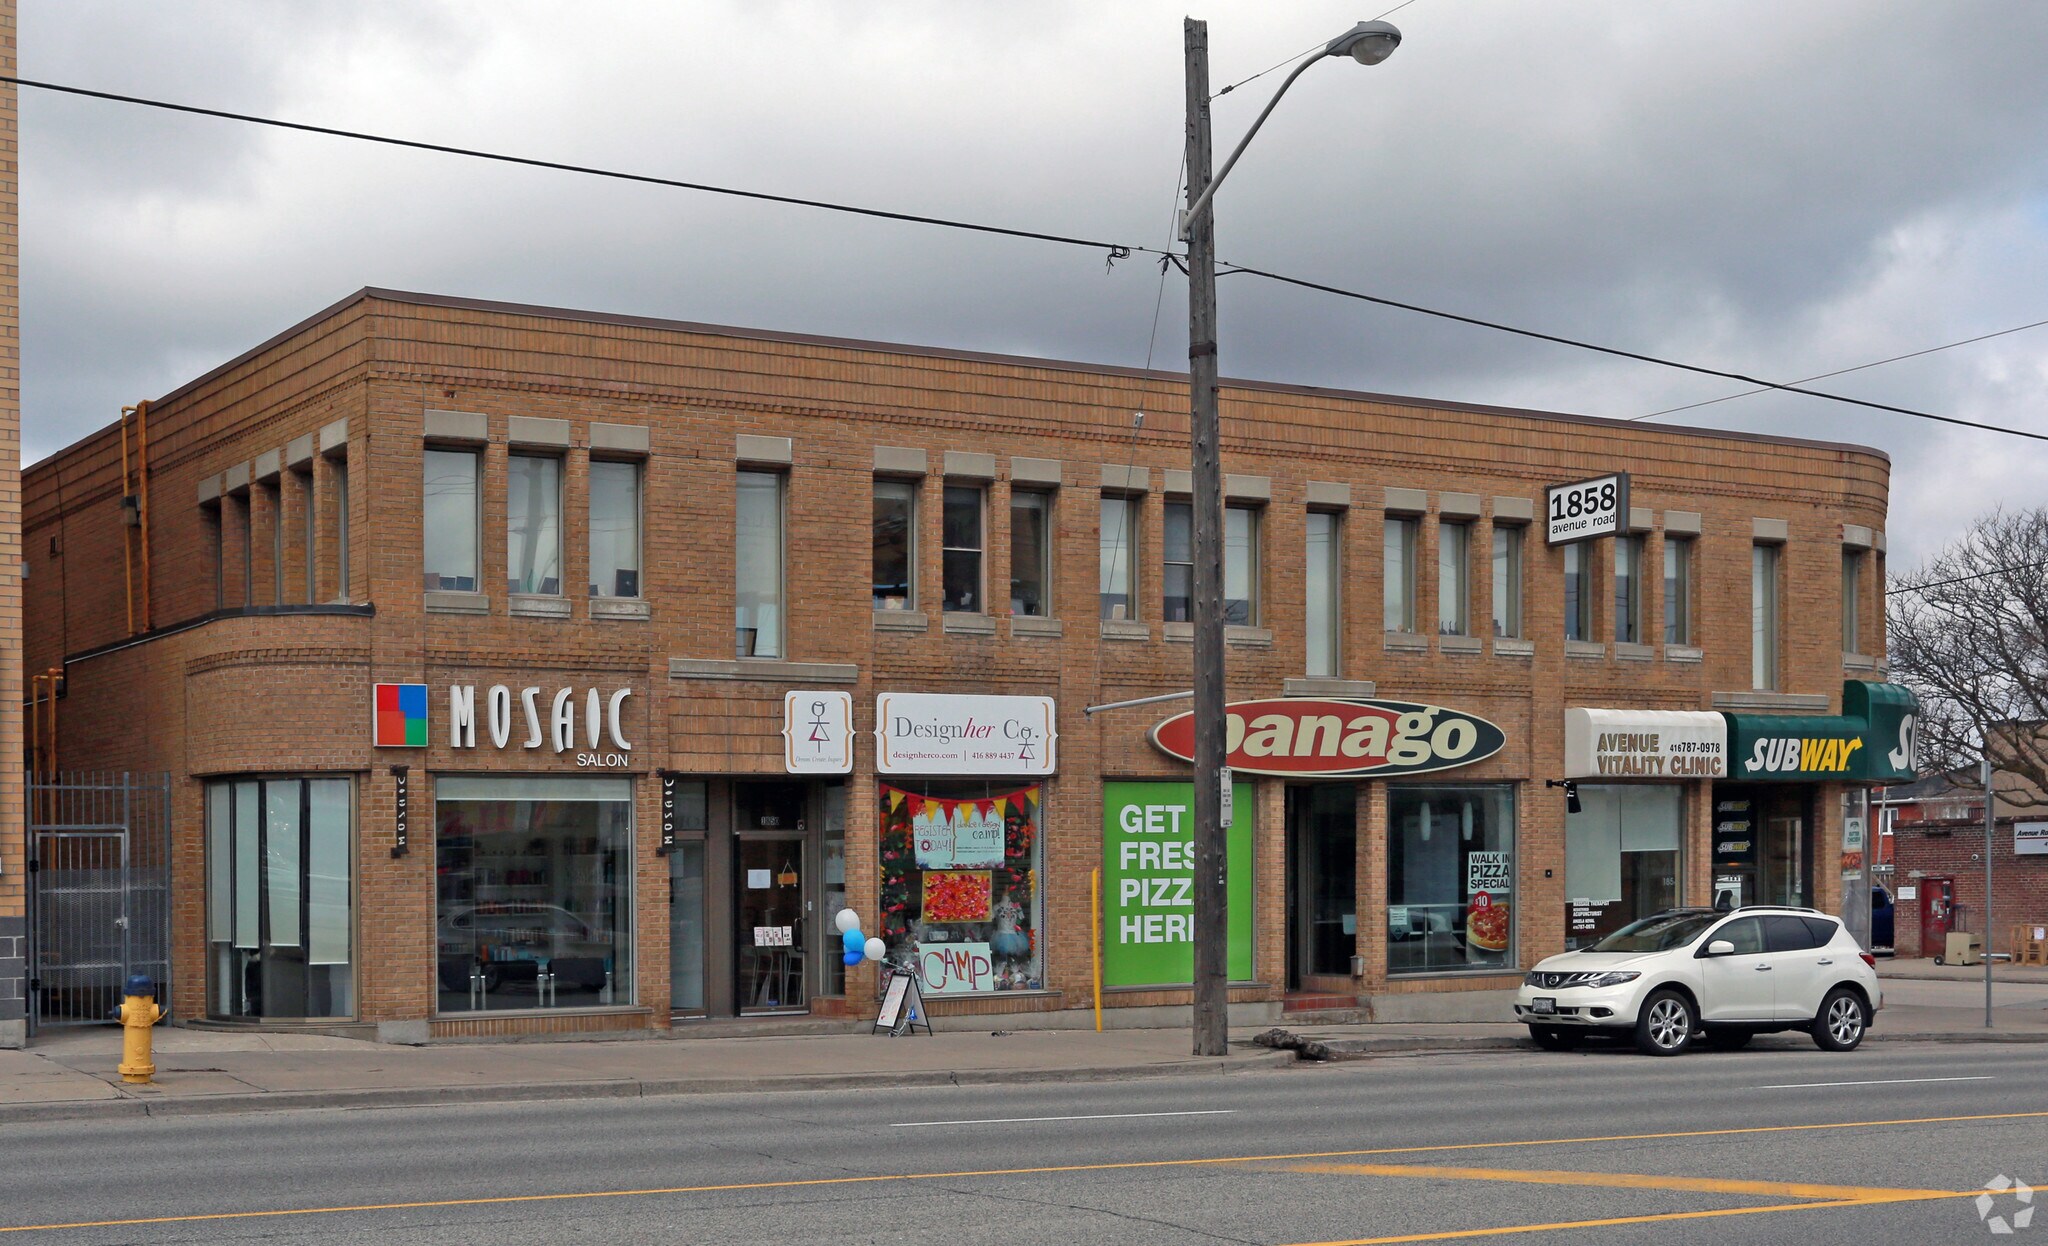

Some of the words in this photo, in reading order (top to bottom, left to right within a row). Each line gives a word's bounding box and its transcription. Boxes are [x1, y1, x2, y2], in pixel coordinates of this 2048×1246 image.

[1551, 483, 1616, 521] 1858
[1552, 519, 1587, 535] avenue
[1592, 511, 1615, 527] road
[450, 684, 632, 754] MOSAIC
[894, 716, 996, 745] Designher
[1597, 732, 1660, 753] AVENUE
[576, 753, 628, 767] SALON
[892, 751, 958, 760] designherco.com
[971, 751, 984, 760] 416
[984, 752, 998, 760] 889
[998, 752, 1015, 760] 4437
[1744, 736, 1863, 772] SUBWAY
[1597, 755, 1666, 775] VITALITY
[1670, 755, 1722, 775] CLINIC
[1119, 804, 1186, 834] GET
[1717, 820, 1751, 833] SUBWAY
[914, 824, 951, 837] REGISTER
[972, 828, 1001, 846] camp!
[914, 838, 952, 853] TODAY!
[1120, 840, 1195, 870] FRES
[1717, 840, 1751, 854] SUBWAY
[1470, 853, 1500, 864] WALK
[1470, 864, 1510, 879] PIZZA
[1120, 877, 1195, 907] PIZZ
[1470, 878, 1510, 890] SPECIAL
[1475, 895, 1493, 907] $10
[1120, 914, 1195, 944] HER
[923, 947, 990, 990] CAMP
